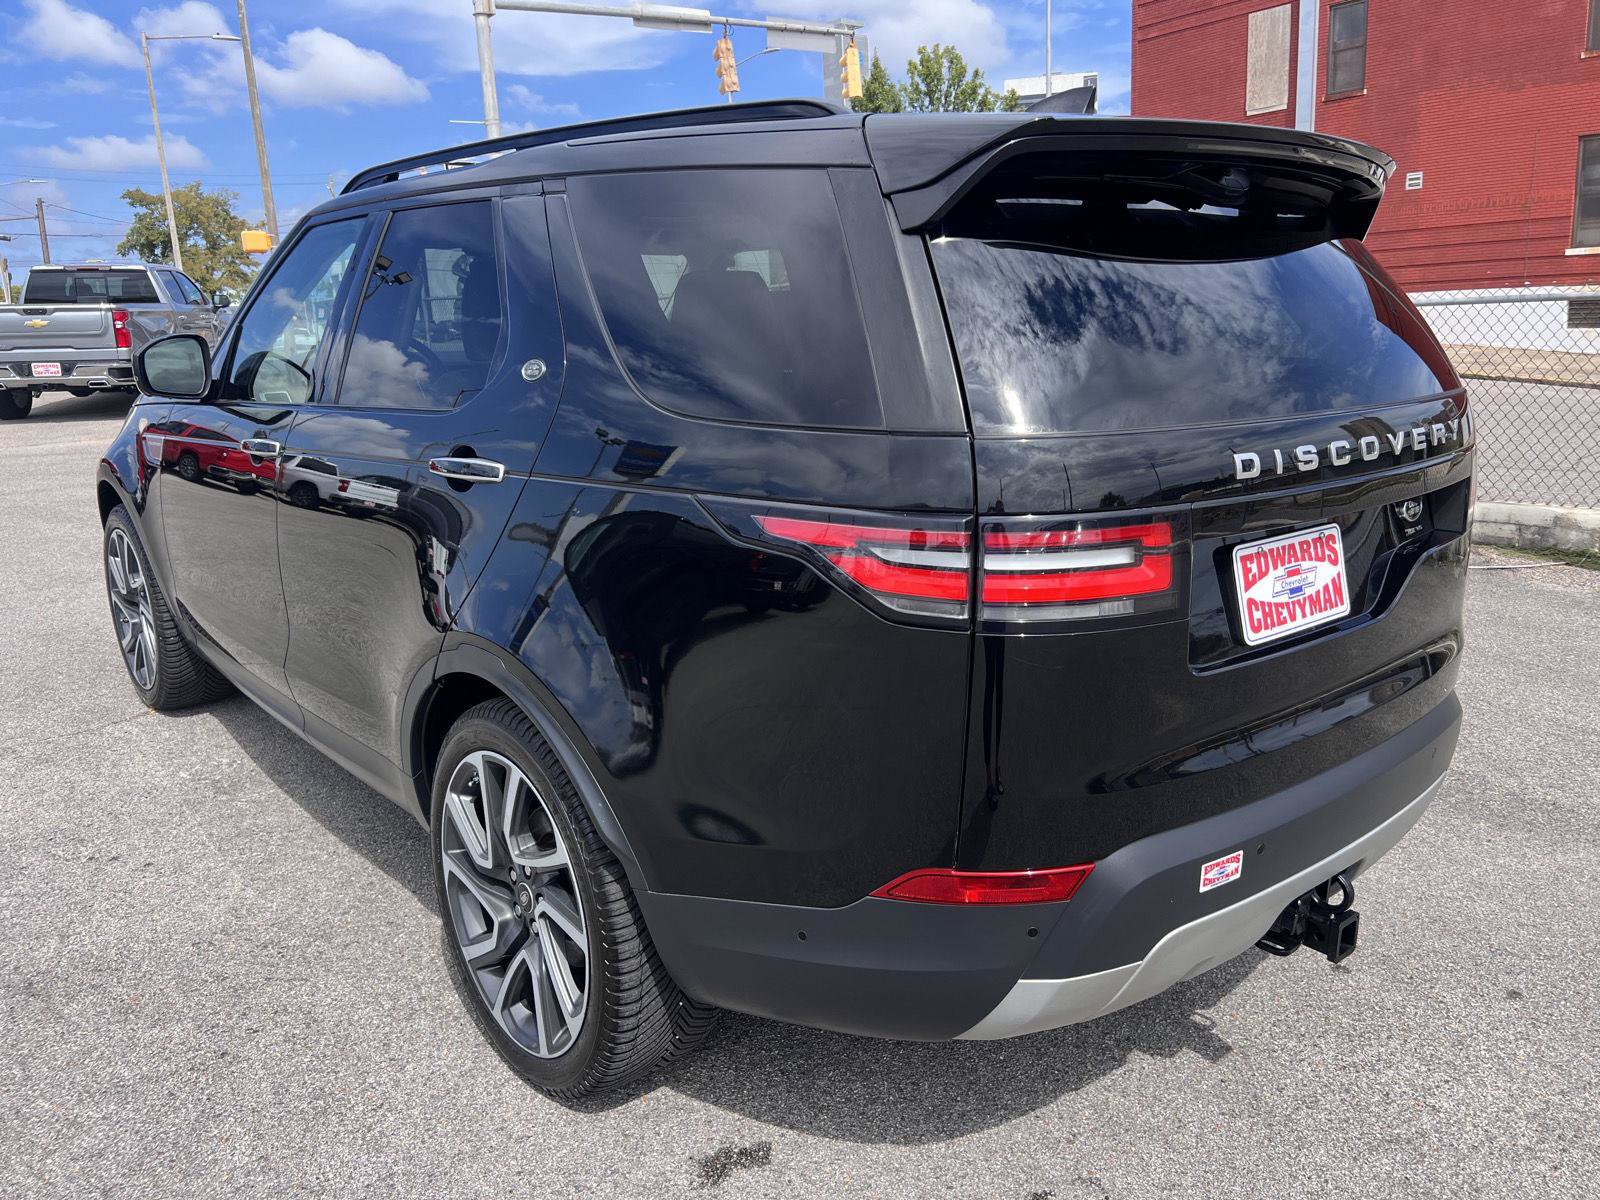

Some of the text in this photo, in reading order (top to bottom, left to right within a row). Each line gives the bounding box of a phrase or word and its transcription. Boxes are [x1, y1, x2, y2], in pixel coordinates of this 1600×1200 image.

[1233, 418, 1460, 480] DISCOVERY
[1239, 533, 1339, 593] EDWARDS
[1281, 575, 1309, 589] Chevrolet
[1246, 571, 1344, 634] CHEVYMAN
[1204, 853, 1241, 876] EDWARDS
